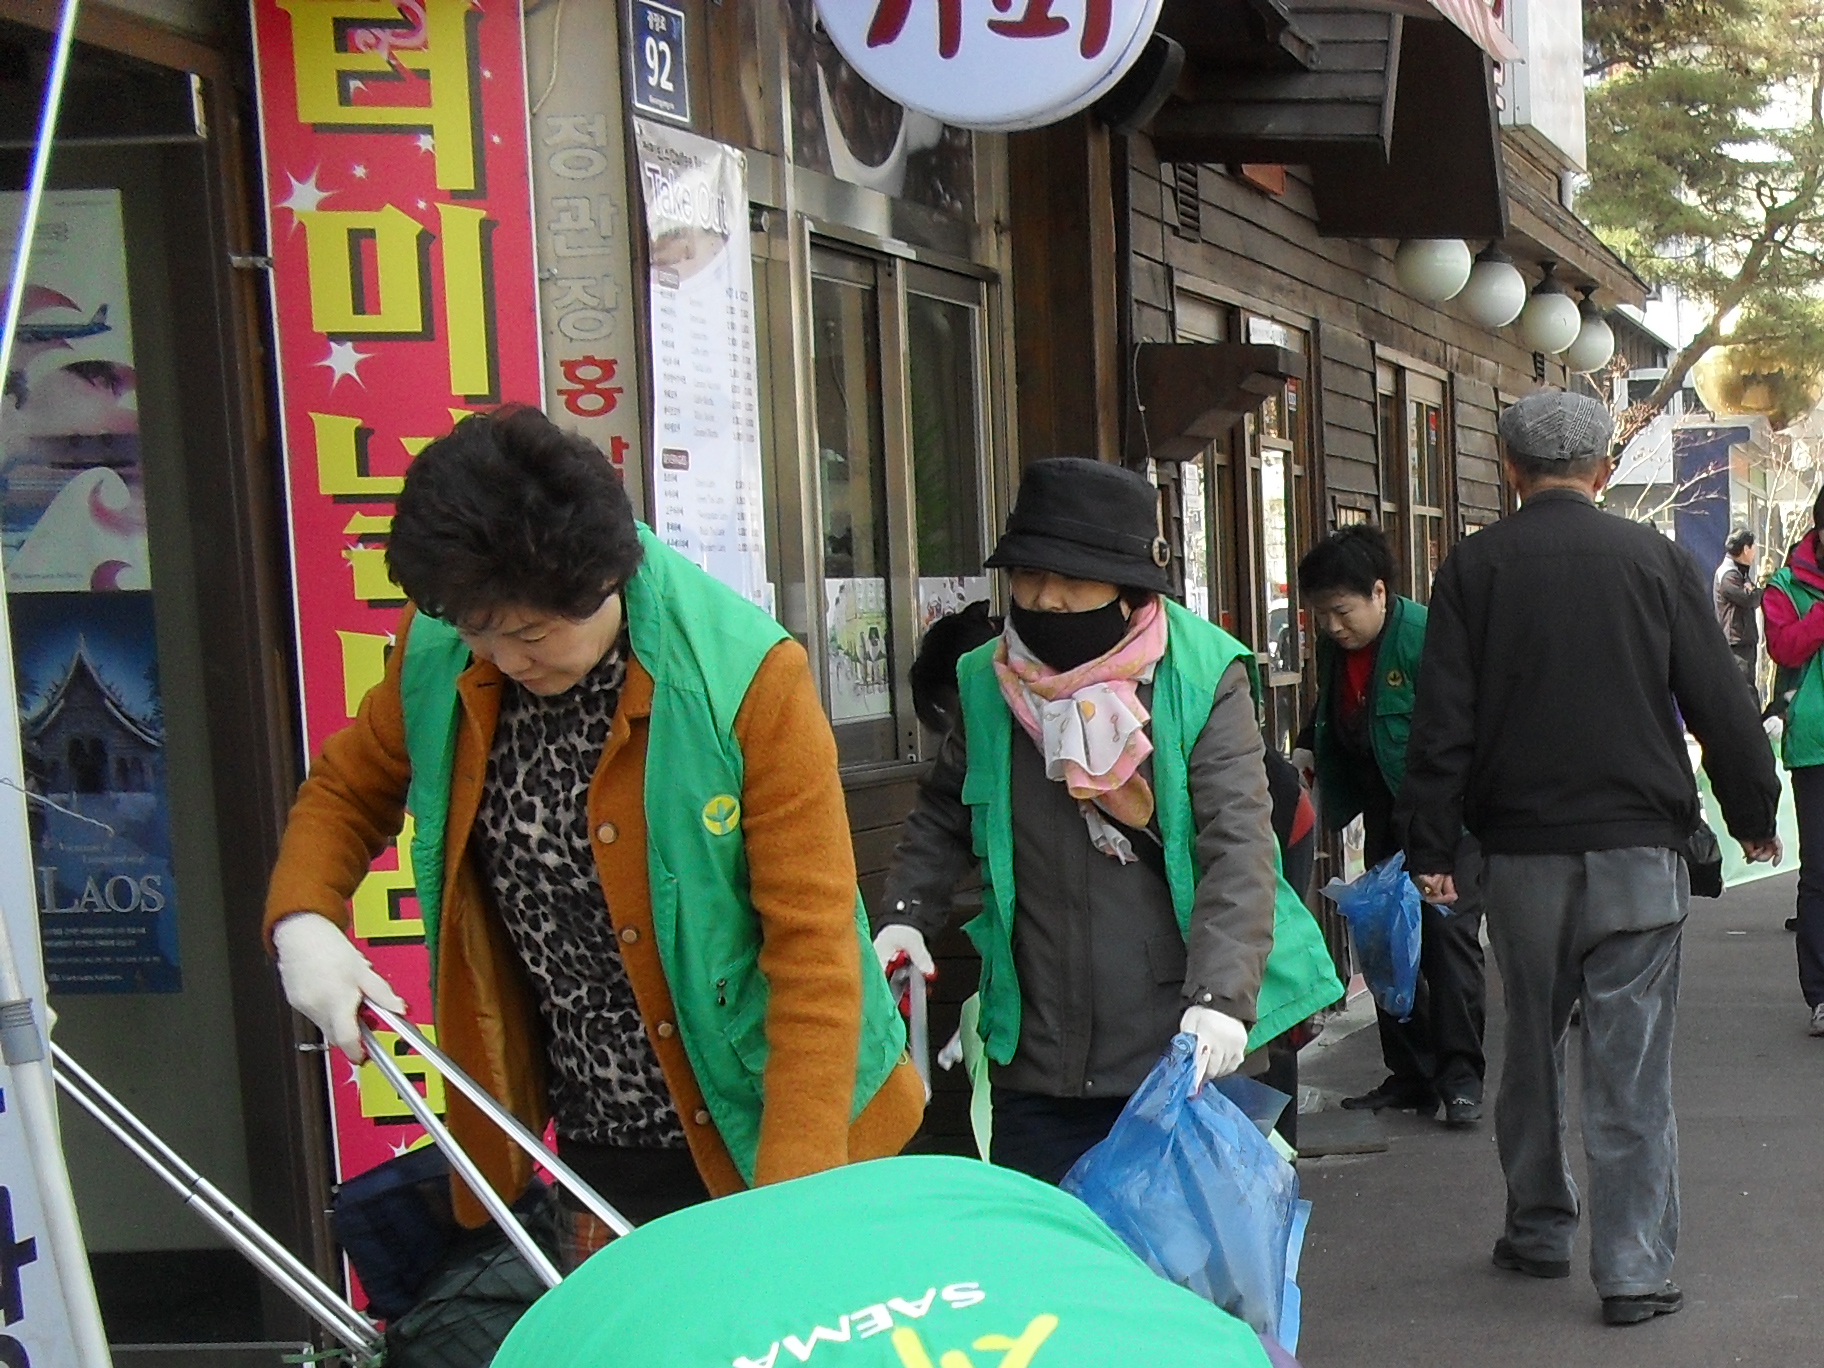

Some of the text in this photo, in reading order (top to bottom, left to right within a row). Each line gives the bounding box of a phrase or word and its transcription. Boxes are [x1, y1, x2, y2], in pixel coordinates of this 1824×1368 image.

[645, 35, 674, 92] 92
[644, 159, 730, 236] Take Out
[556, 354, 630, 492] 홍
[38, 866, 166, 914] LAOS
